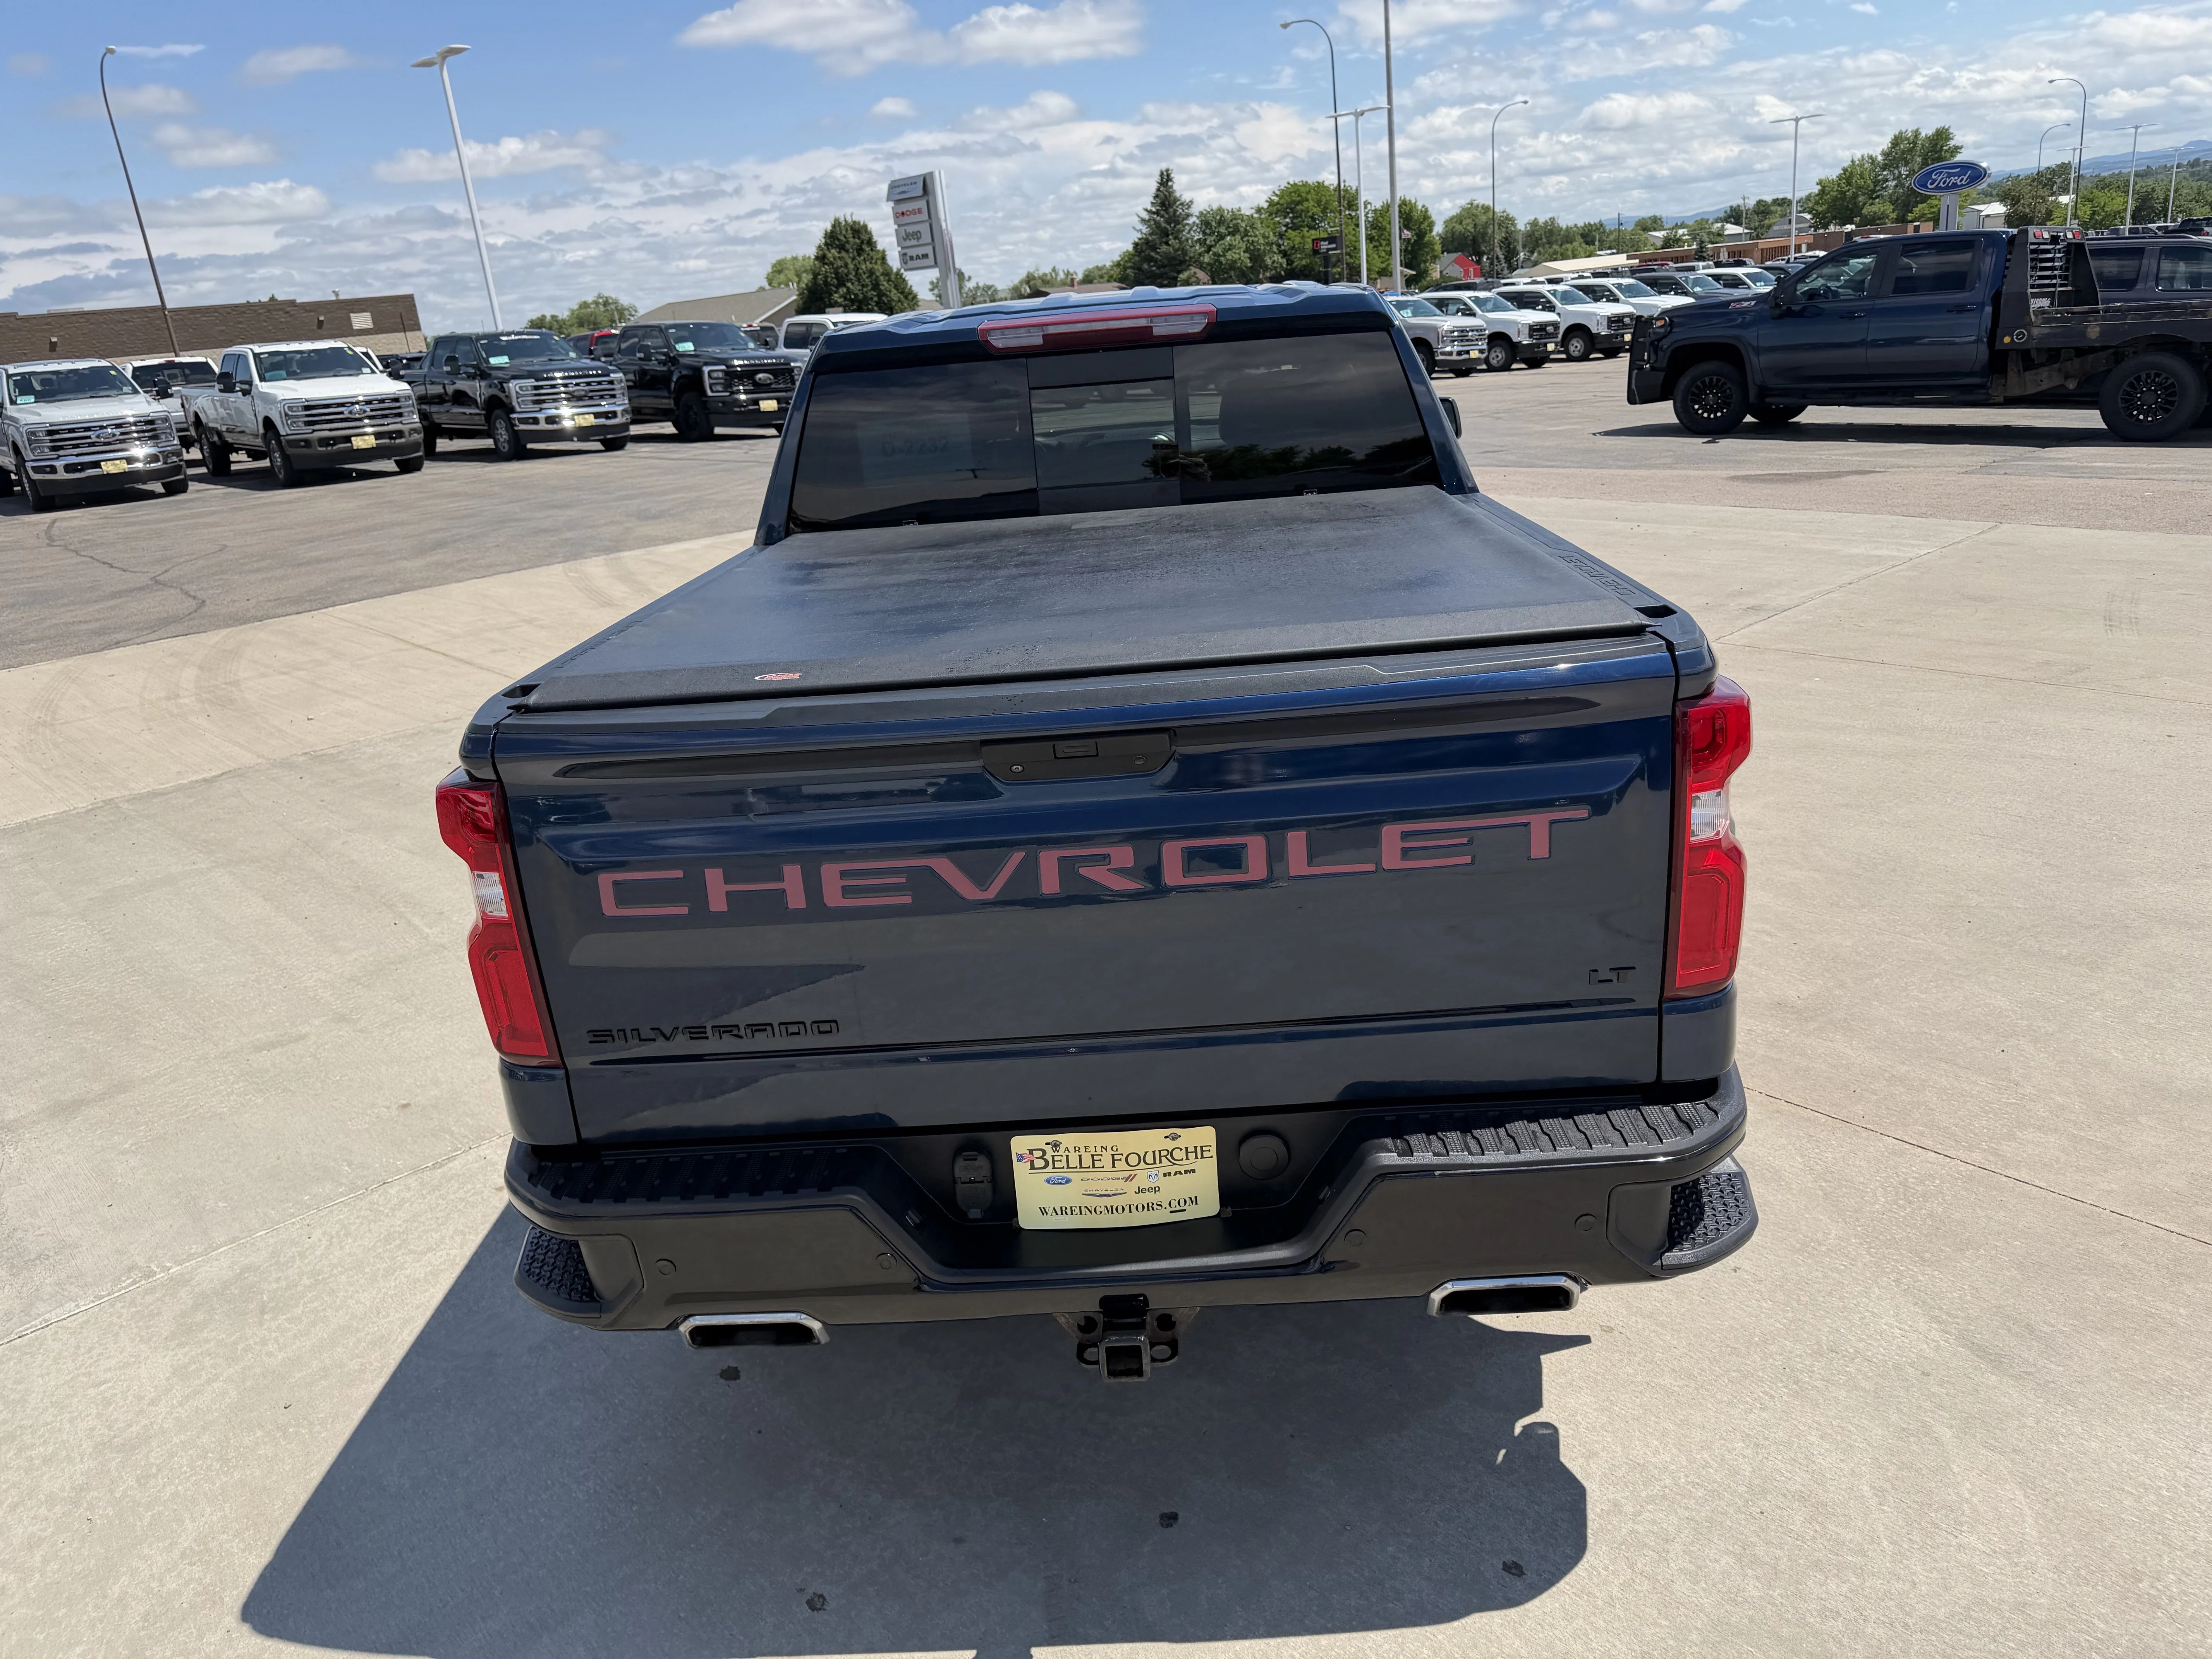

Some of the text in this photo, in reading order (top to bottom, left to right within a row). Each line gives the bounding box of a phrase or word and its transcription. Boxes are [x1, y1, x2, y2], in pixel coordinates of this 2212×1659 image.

[1927, 168, 1971, 189] Ford
[895, 207, 923, 218] DODGE
[902, 229, 922, 242] Jeep
[909, 252, 929, 262] RAM
[1557, 555, 1636, 595] CHEVROLET
[597, 809, 1590, 917] CHEVROLET
[1589, 966, 1636, 985] LT
[586, 1019, 840, 1044] SILVERADO
[1027, 1145, 1213, 1170] BELLE FOURCHE
[1051, 1145, 1119, 1153] WAREING
[1163, 1168, 1196, 1178] RAM
[1134, 1186, 1160, 1194] Jeep
[1038, 1195, 1199, 1216] WAREINGMOTORS.COM
